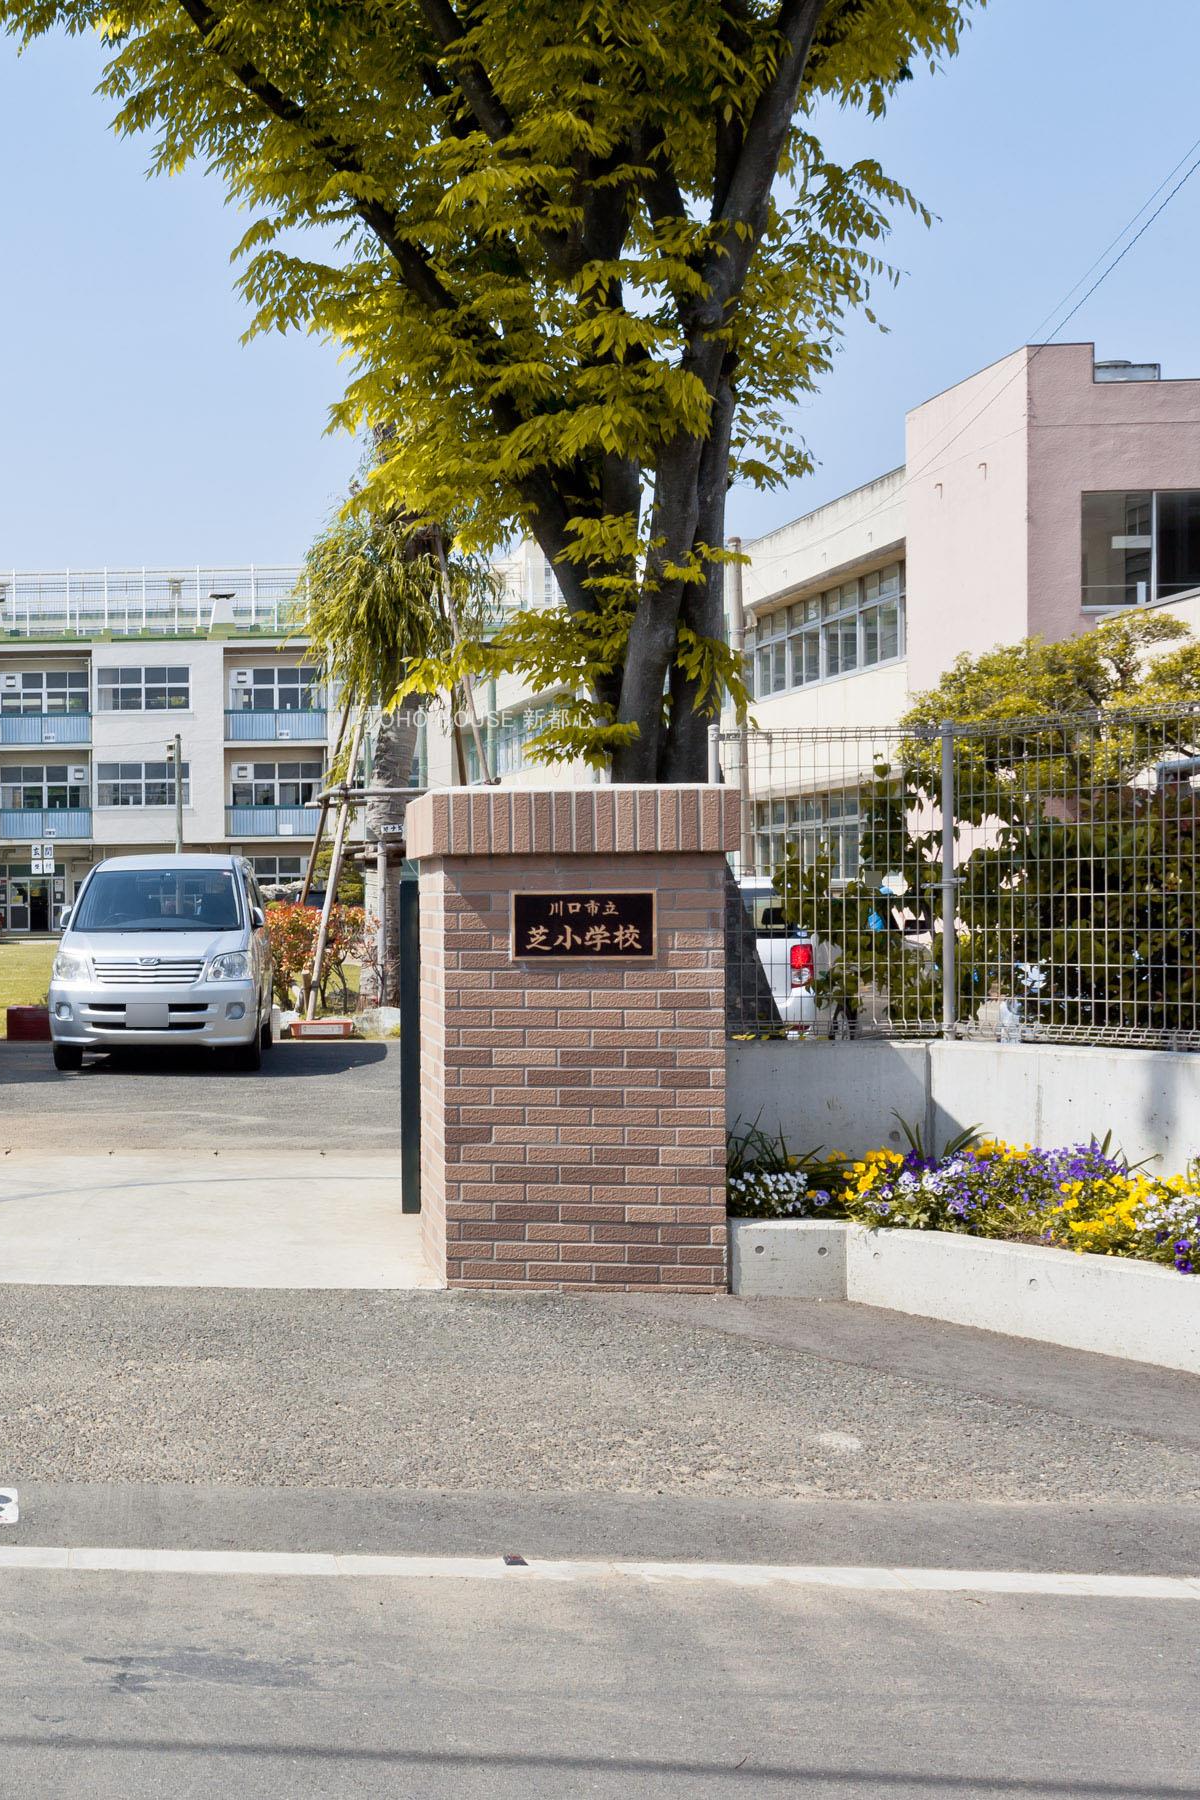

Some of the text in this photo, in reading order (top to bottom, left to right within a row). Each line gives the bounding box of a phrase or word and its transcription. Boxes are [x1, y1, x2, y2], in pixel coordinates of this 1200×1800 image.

[548, 900, 620, 917] 川口市立
[525, 924, 643, 952] 芝小学校
